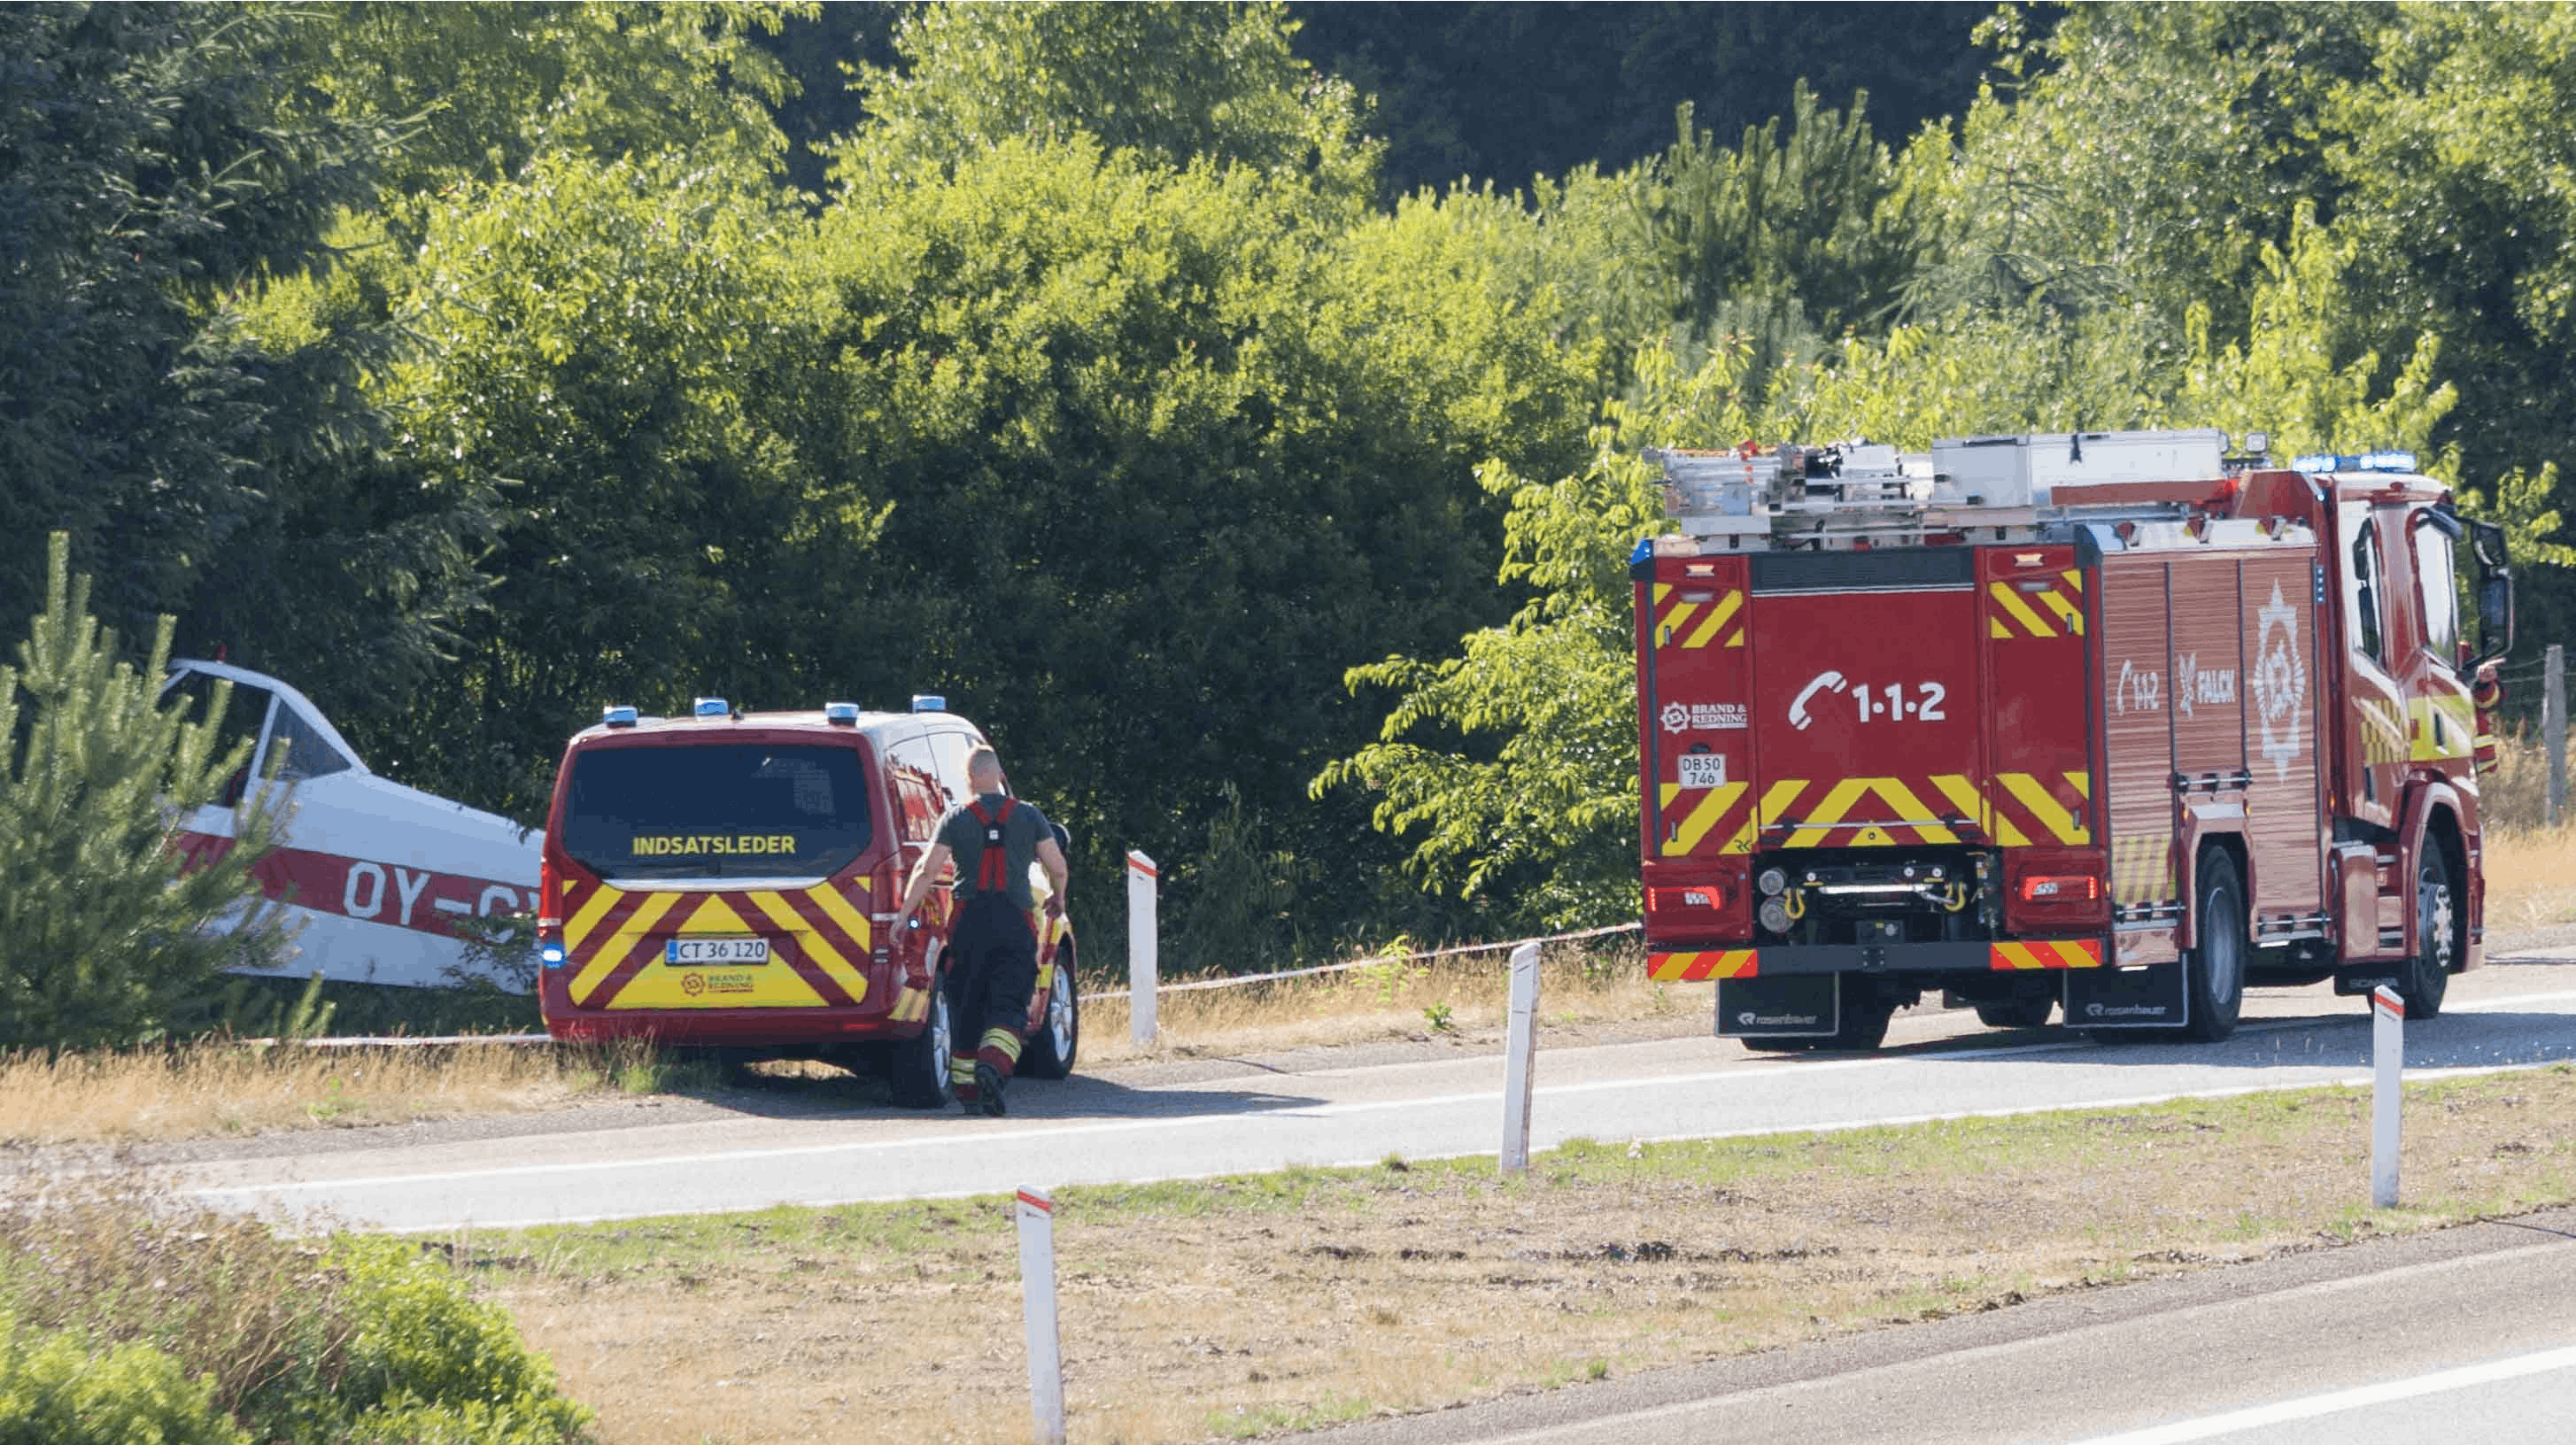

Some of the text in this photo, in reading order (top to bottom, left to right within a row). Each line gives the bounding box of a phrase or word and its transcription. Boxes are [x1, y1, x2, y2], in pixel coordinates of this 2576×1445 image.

[1692, 703, 1736, 714] BRAND
[1692, 714, 1747, 723] REDNING
[1690, 772, 1715, 785] 746
[632, 835, 796, 855] INDSATSLEDER
[679, 942, 766, 959] CT 36 120
